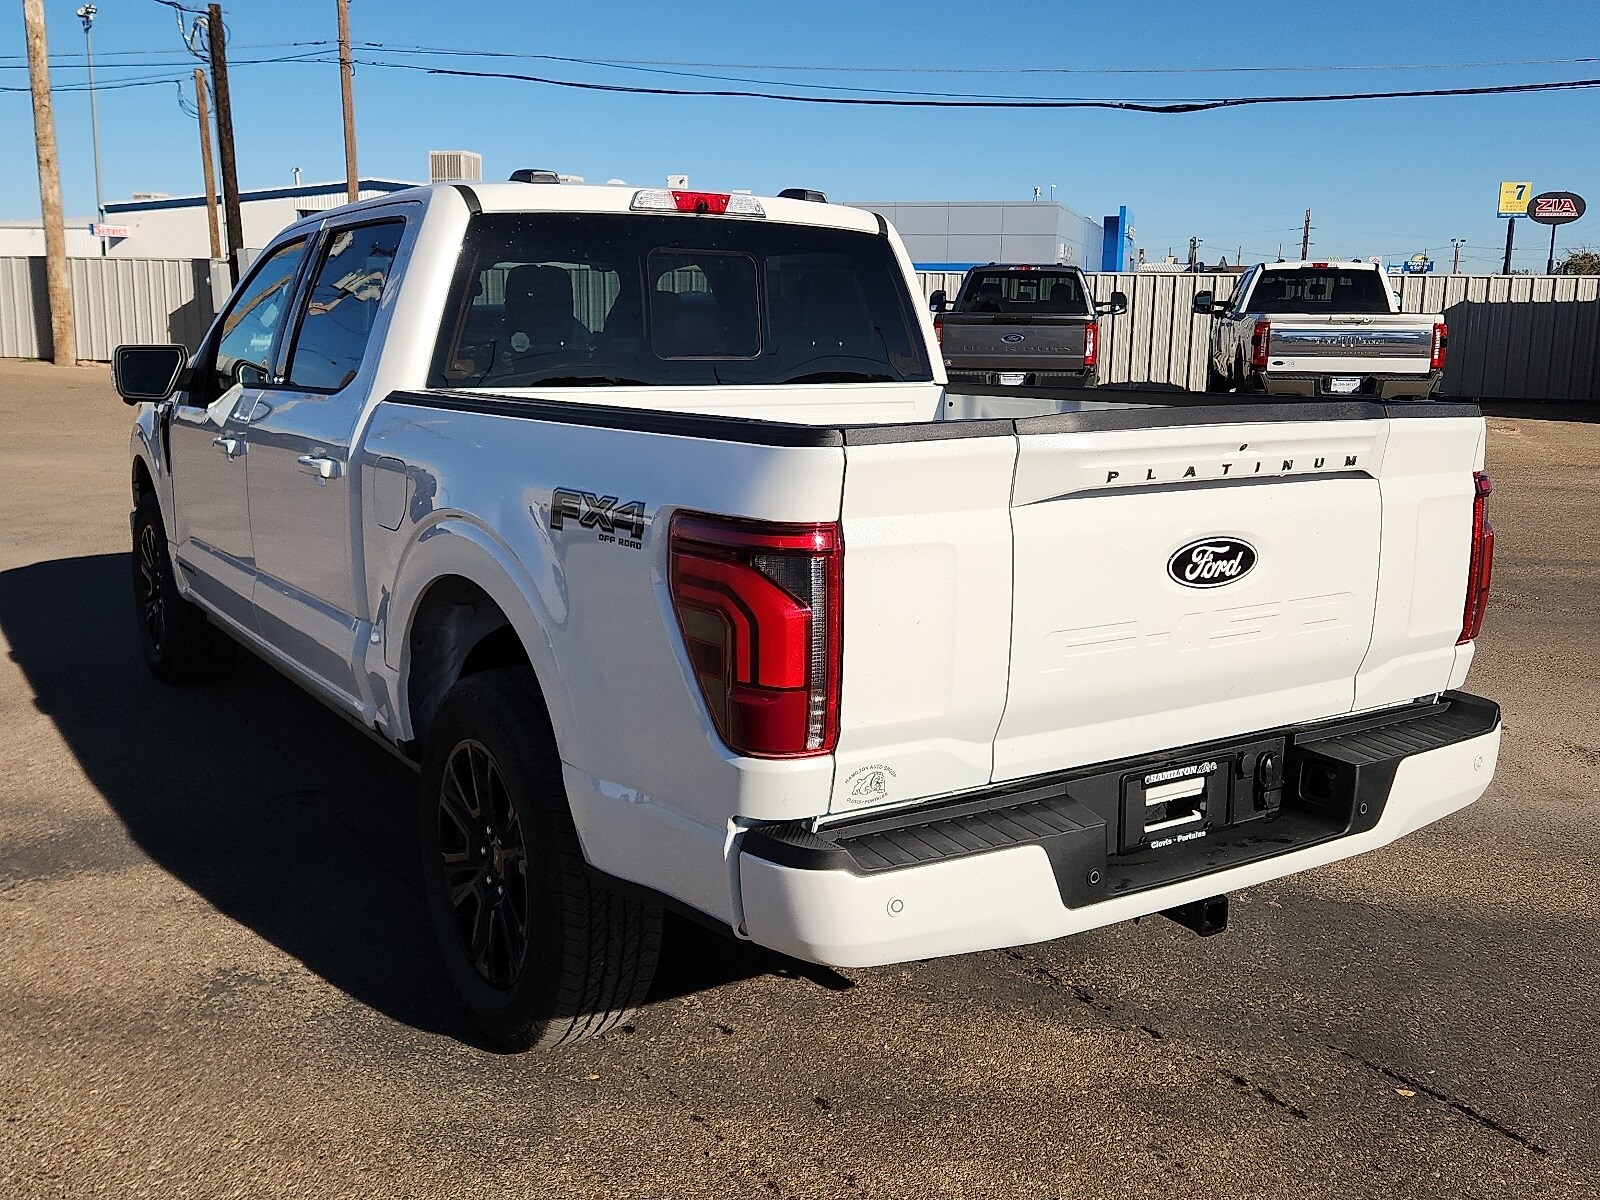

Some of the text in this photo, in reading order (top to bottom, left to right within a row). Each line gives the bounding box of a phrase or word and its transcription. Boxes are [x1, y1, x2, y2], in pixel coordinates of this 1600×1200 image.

[1514, 184, 1526, 201] 7
[1536, 198, 1577, 213] ZIA
[1106, 454, 1358, 484] PLATINUM
[550, 487, 646, 541] FX4
[598, 533, 642, 551] OFF ROAD
[1184, 544, 1244, 581] Ford
[1150, 838, 1173, 850] Clovis
[1177, 830, 1207, 843] Portales
